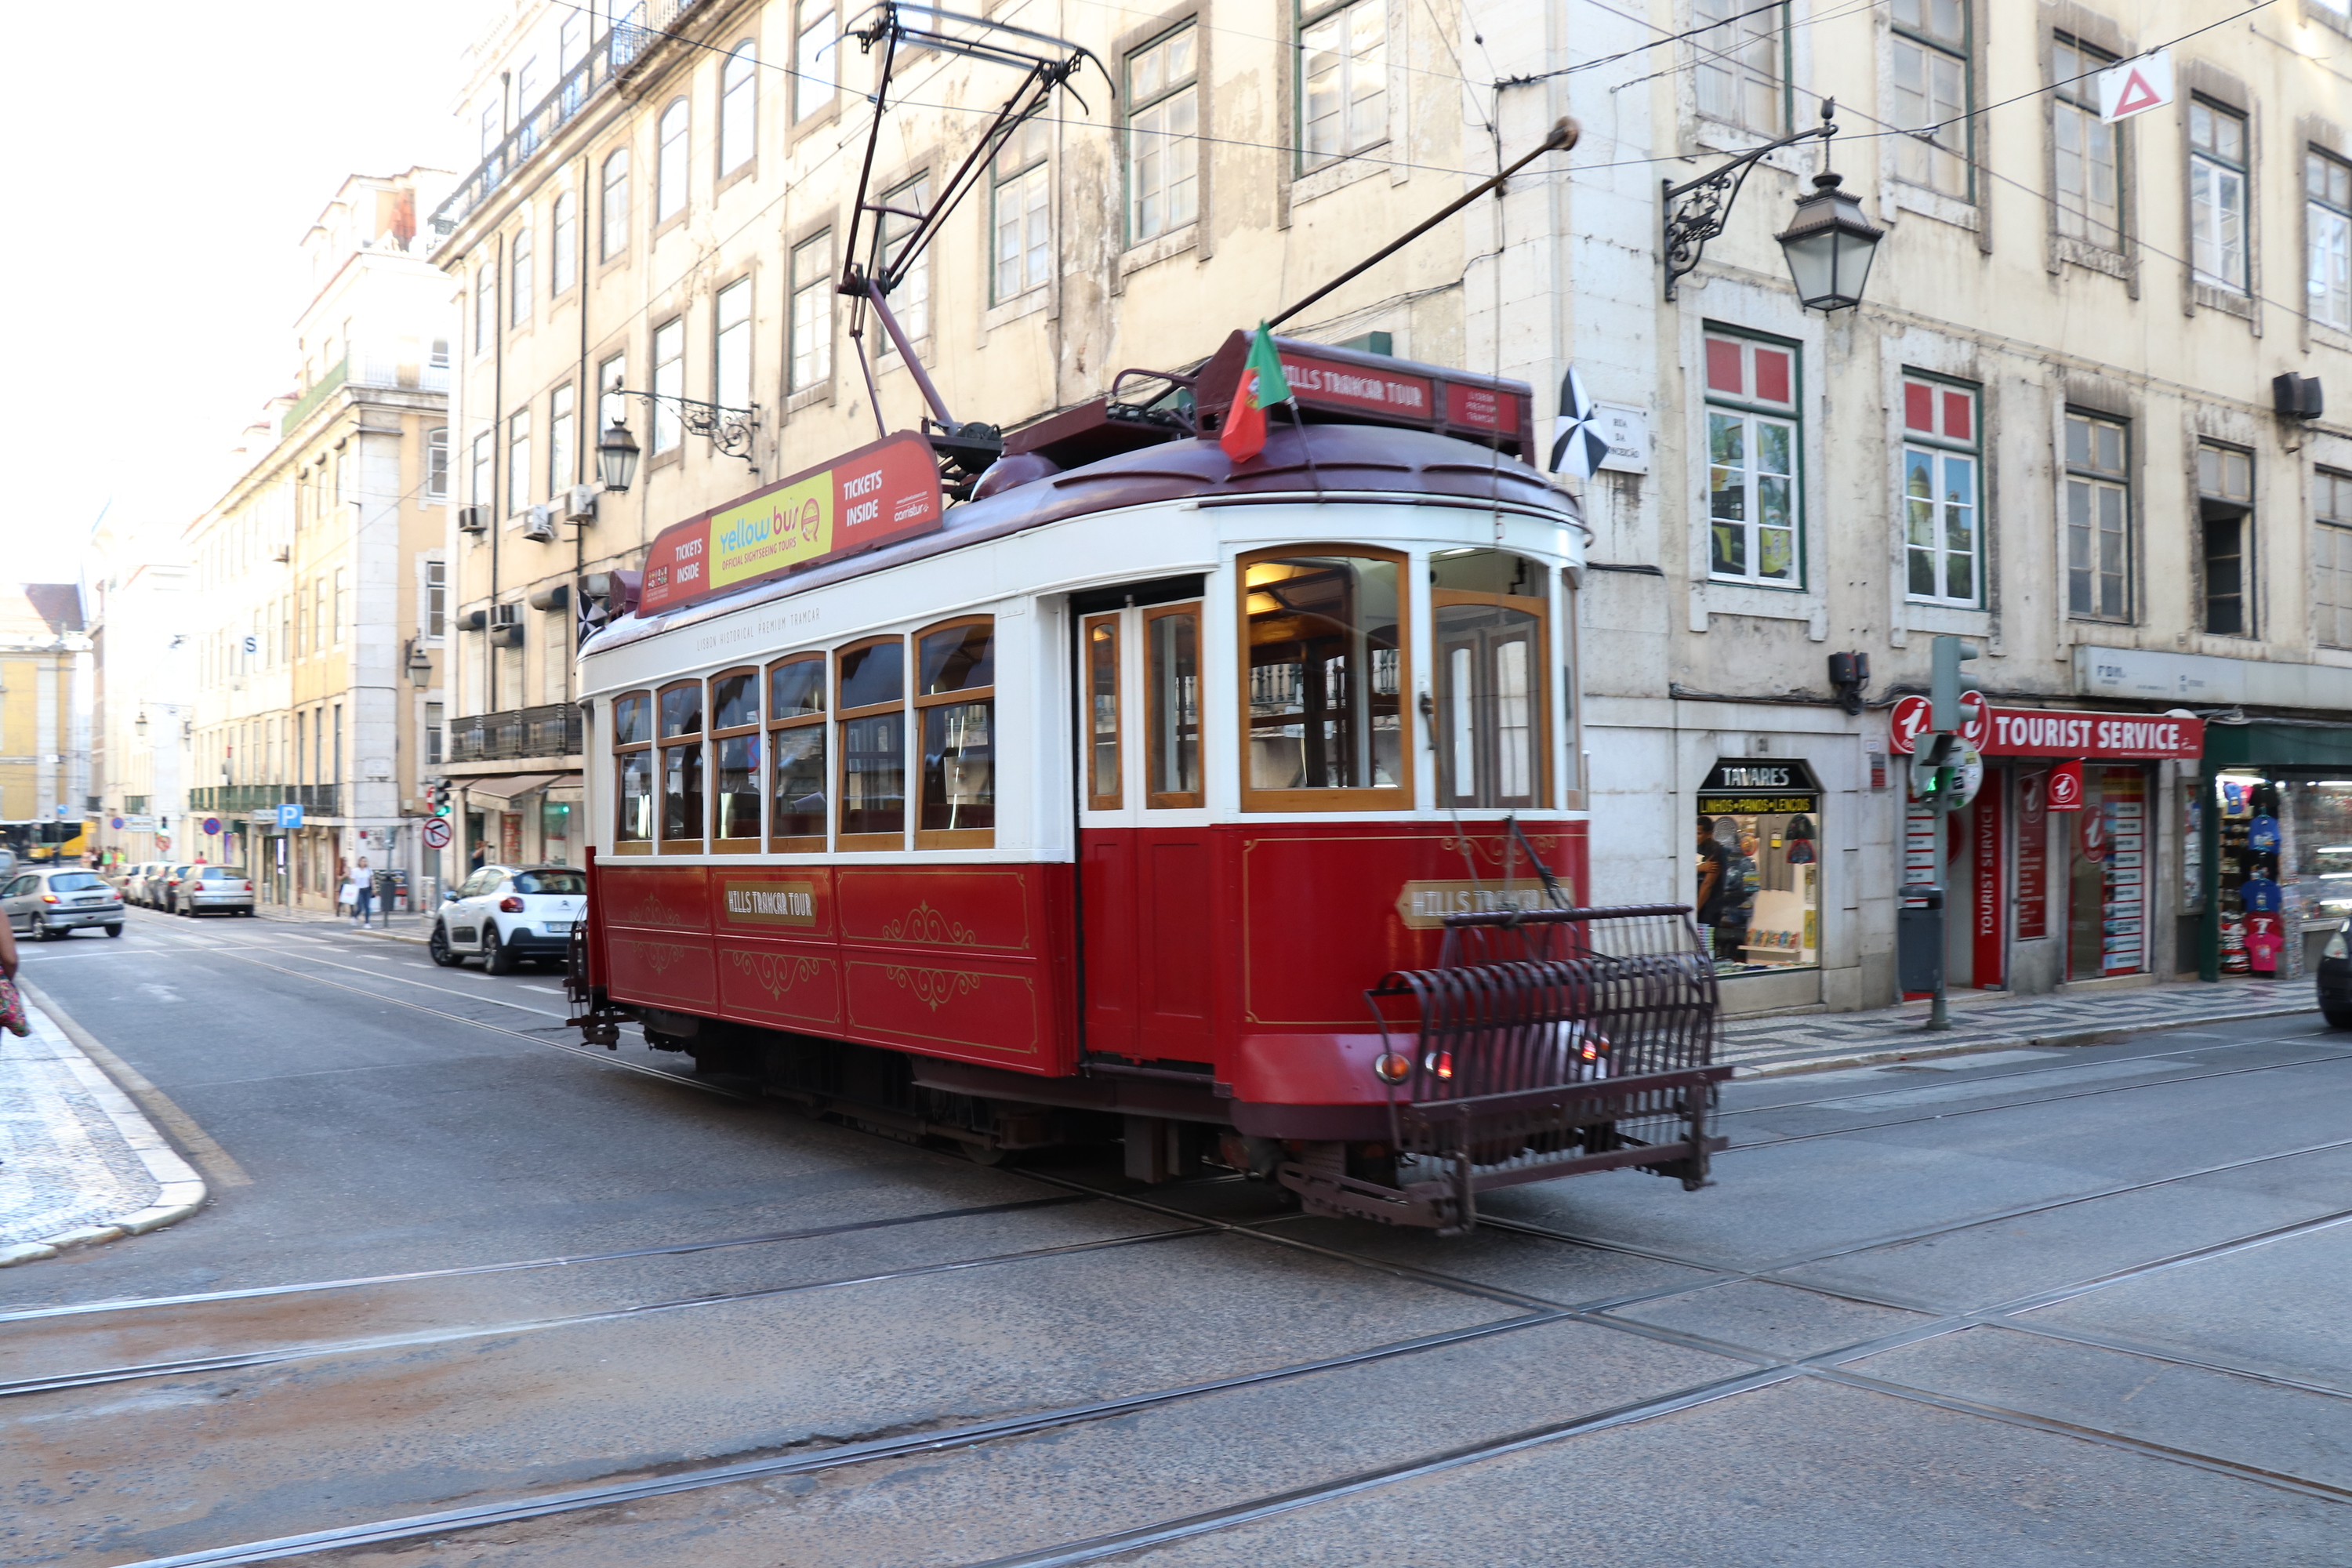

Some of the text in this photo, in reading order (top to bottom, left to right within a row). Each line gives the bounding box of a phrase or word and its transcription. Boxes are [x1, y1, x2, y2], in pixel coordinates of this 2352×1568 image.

[1323, 371, 1385, 401] TRAMCAR
[1385, 382, 1424, 407] TOUR
[1613, 418, 1628, 428] RUA
[1615, 433, 1626, 441] DA
[844, 470, 883, 500] TICKETS
[847, 499, 879, 527] INSIDE
[720, 506, 799, 554] yellow bus
[675, 538, 702, 562] TICKETS
[722, 537, 797, 571] OFFICIAL SIGHTSEEING TOURS
[677, 561, 699, 583] INSIDE
[697, 608, 820, 651] LISBON HISTORICAL PREMIUM TRAMCAR
[1996, 716, 2093, 748] TOURIST
[2097, 720, 2180, 750] SERVICE
[1722, 768, 1790, 786] TAVARES
[283, 807, 298, 826] P
[1700, 799, 1734, 813] LINHOS
[1738, 799, 1769, 812] PANOS
[1980, 805, 1994, 936] TOURIST SERVICE
[728, 891, 812, 916] HILLS TRAMCAR TOUR
[1411, 890, 1472, 916] HILLS
